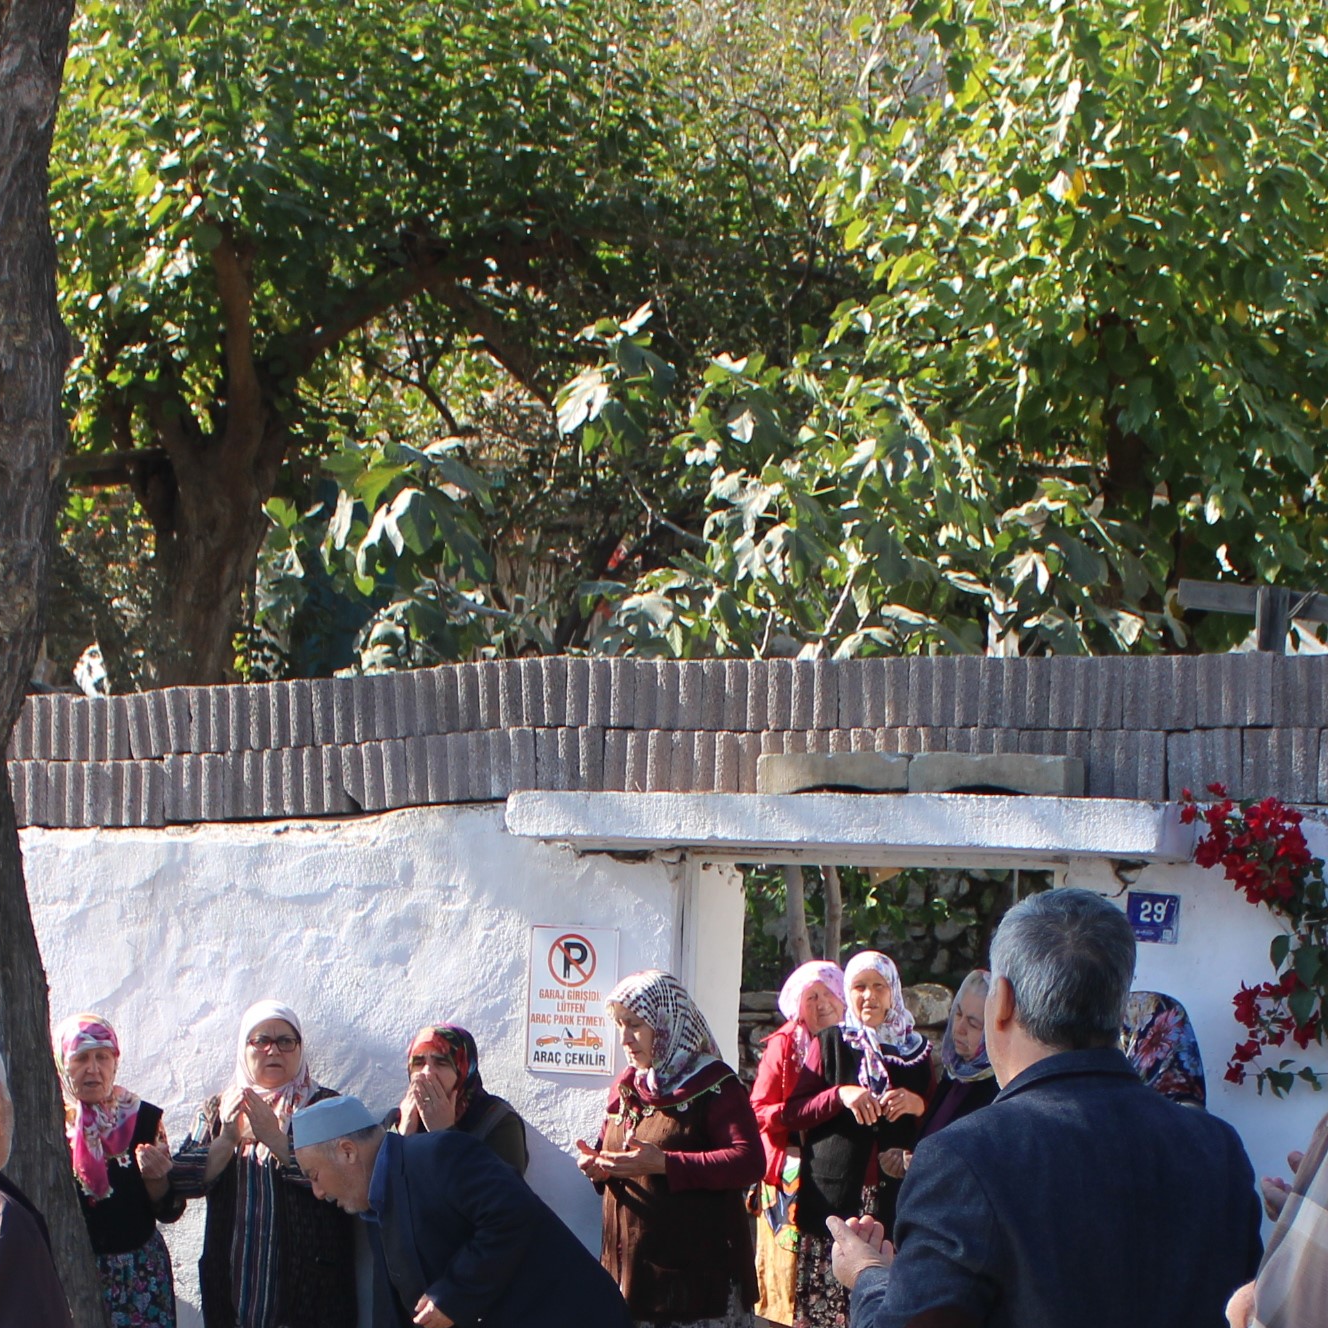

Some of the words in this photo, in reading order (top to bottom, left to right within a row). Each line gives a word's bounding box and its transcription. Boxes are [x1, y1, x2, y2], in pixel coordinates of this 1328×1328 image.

[539, 988, 565, 1000] GARAJ
[567, 988, 602, 1003] GİRİŞİDİ
[557, 1000, 586, 1013] LÜTFEN
[531, 1013, 552, 1026] ARAÇ
[553, 1014, 575, 1025] PARK
[533, 1050, 561, 1066] ARAÇ
[565, 1050, 606, 1067] ÇEKİLİR
